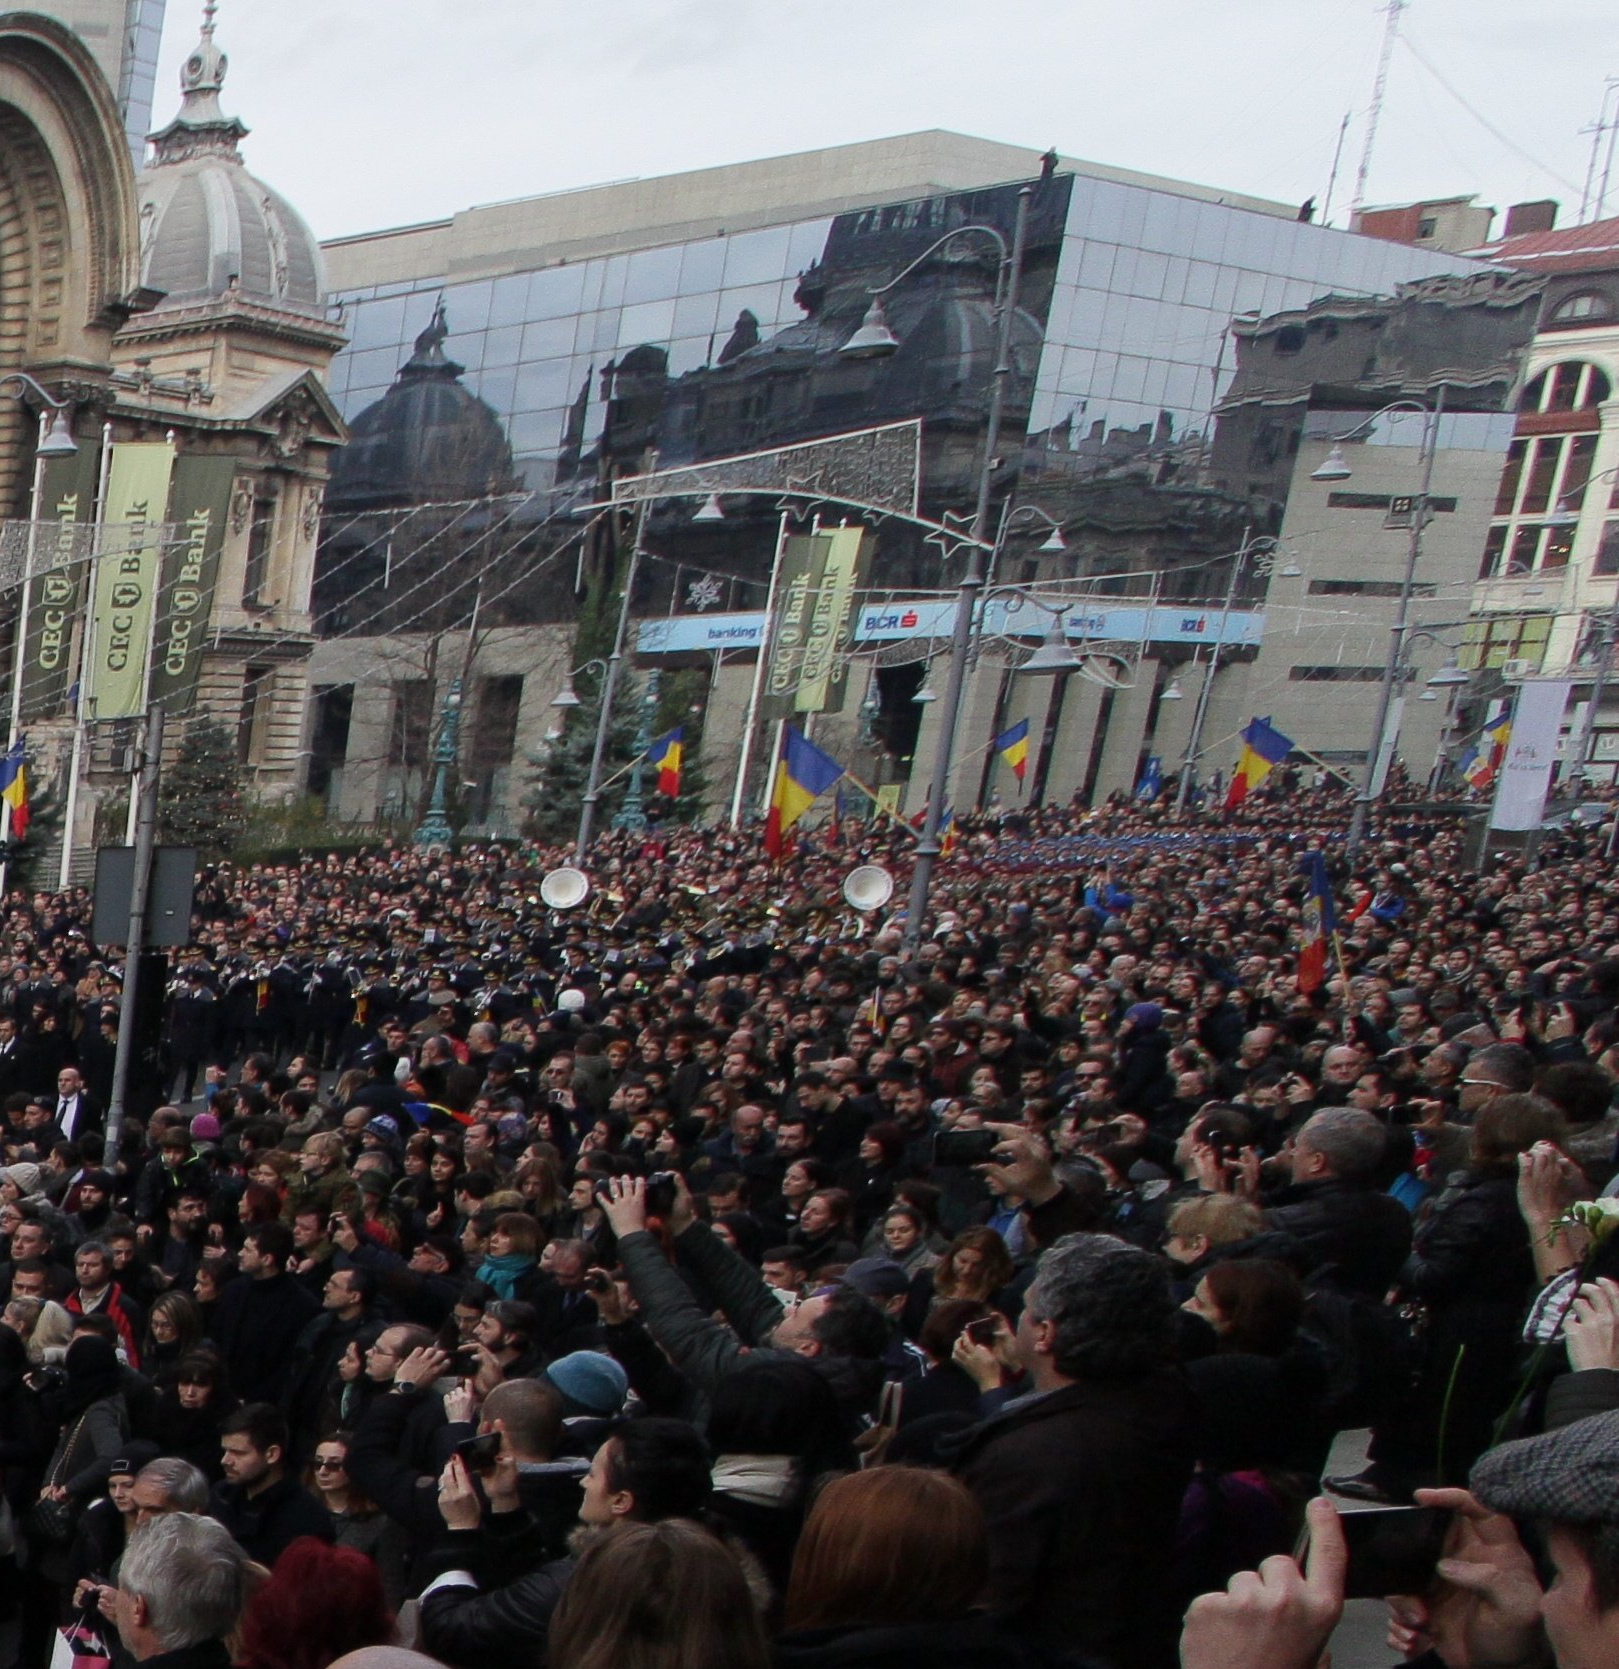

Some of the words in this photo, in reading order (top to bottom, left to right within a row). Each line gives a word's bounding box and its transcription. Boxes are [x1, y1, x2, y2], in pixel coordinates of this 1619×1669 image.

[119, 499, 149, 575] Bank
[165, 619, 192, 677] CEC
[179, 507, 211, 584] Bank
[817, 565, 840, 615] Bank
[39, 610, 65, 670] CEC
[106, 614, 134, 672] CEC
[707, 623, 758, 641] banking
[772, 648, 796, 689] CEC
[784, 572, 812, 624] Bank
[864, 614, 898, 631] BCR
